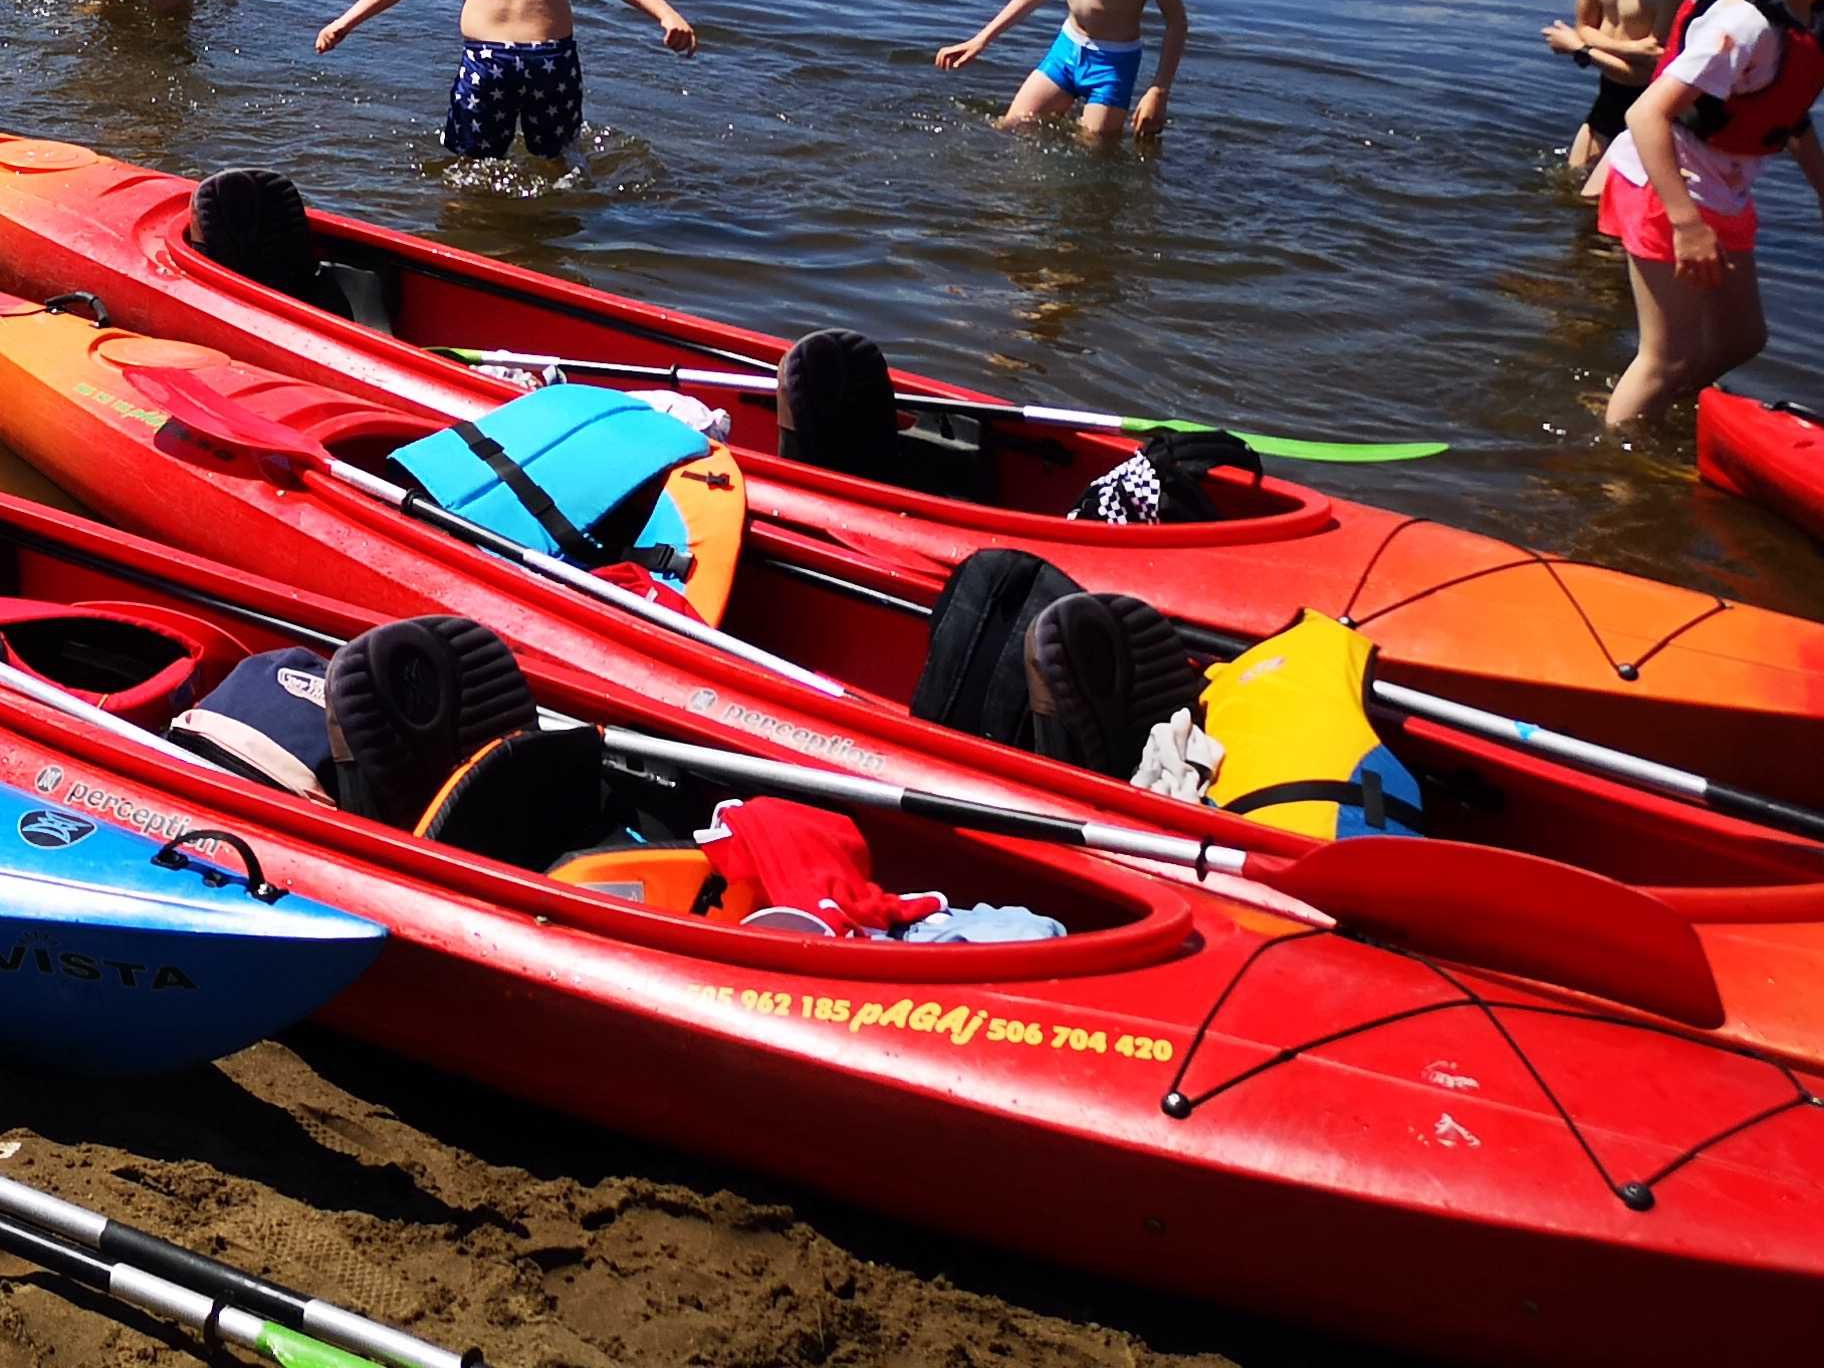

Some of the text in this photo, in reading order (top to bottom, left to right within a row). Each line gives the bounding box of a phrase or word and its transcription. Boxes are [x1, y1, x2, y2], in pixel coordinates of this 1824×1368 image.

[724, 703, 885, 770] perception
[66, 781, 219, 854] perceptin
[739, 989, 792, 1017] 962
[801, 995, 851, 1023] 185
[985, 1018, 1044, 1046] 506
[1050, 1025, 1108, 1054] 704
[1114, 1034, 1174, 1062] 420
